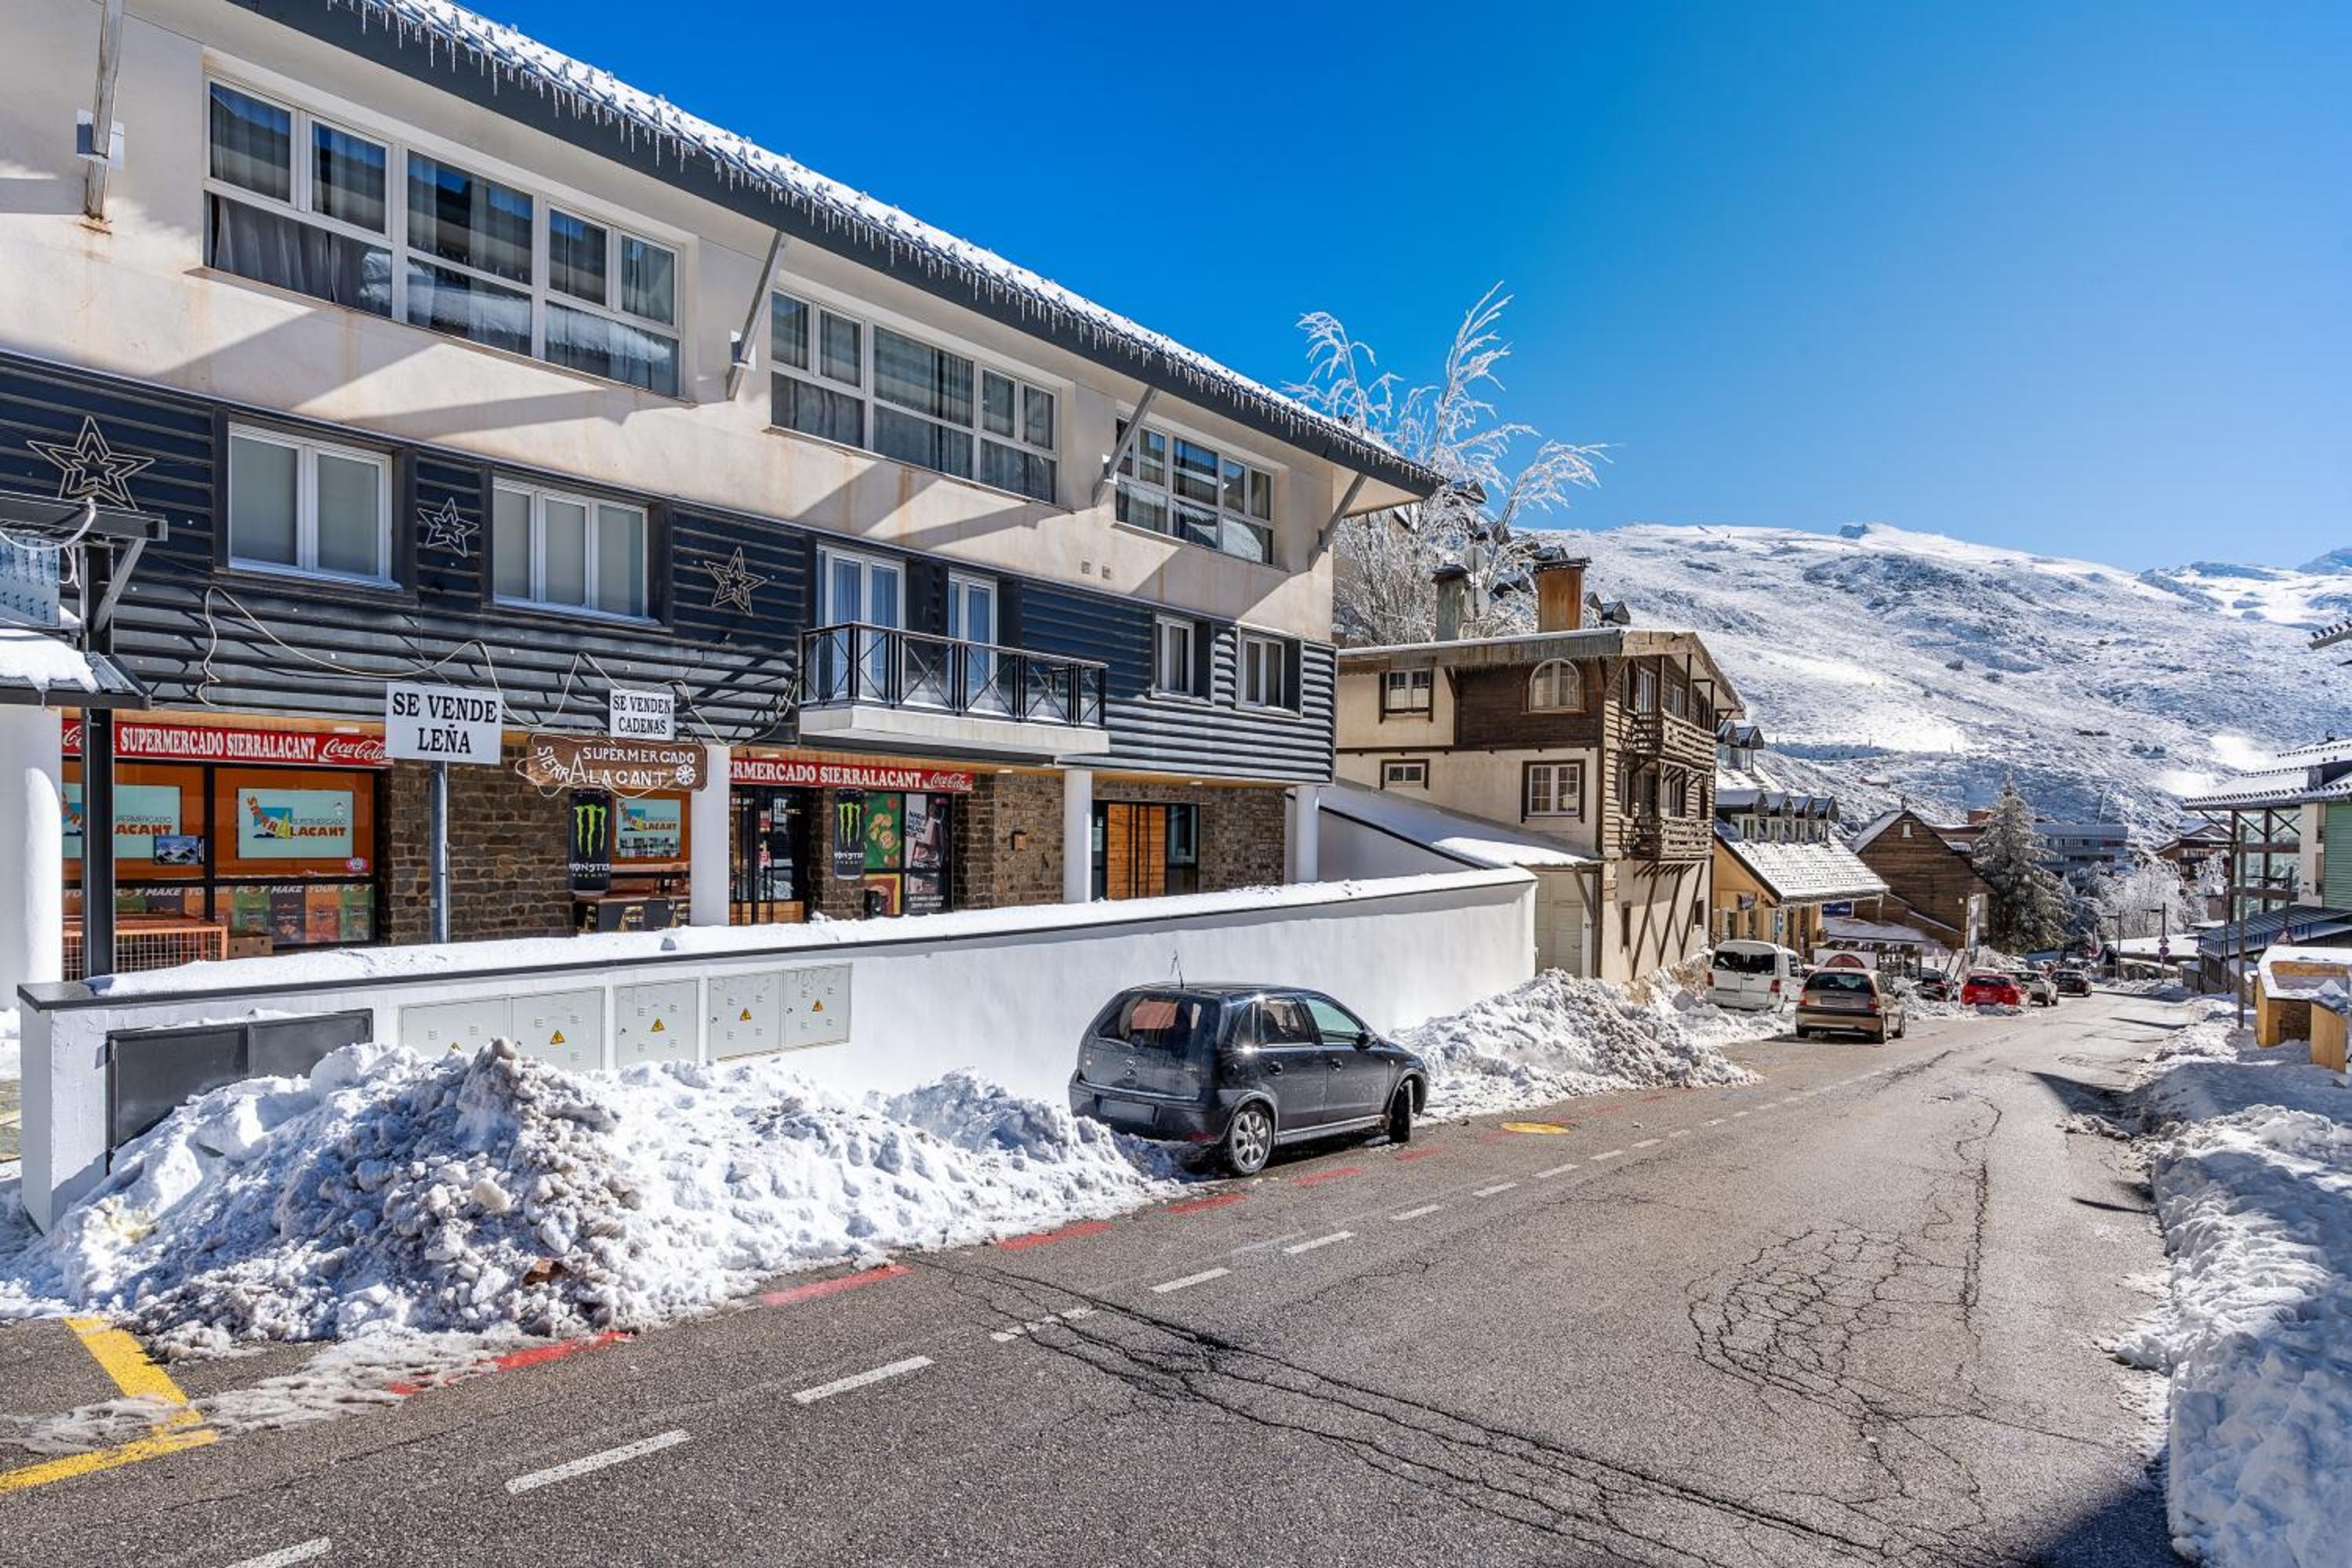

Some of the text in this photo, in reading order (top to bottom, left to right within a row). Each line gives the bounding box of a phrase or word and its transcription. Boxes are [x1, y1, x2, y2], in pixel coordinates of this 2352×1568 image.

[393, 691, 497, 723] SE VENDE
[613, 695, 671, 714] SE VENDEN
[619, 717, 666, 735] CADENAS
[121, 727, 224, 757] SUPERMERCADO
[227, 732, 316, 760] SIERRALACANT
[418, 724, 471, 753] LEÑA
[583, 746, 696, 765] SUPERMERCADO
[729, 760, 816, 782] RMERCADO
[820, 766, 921, 789] SIERRALACANT
[271, 884, 304, 894] MAKE
